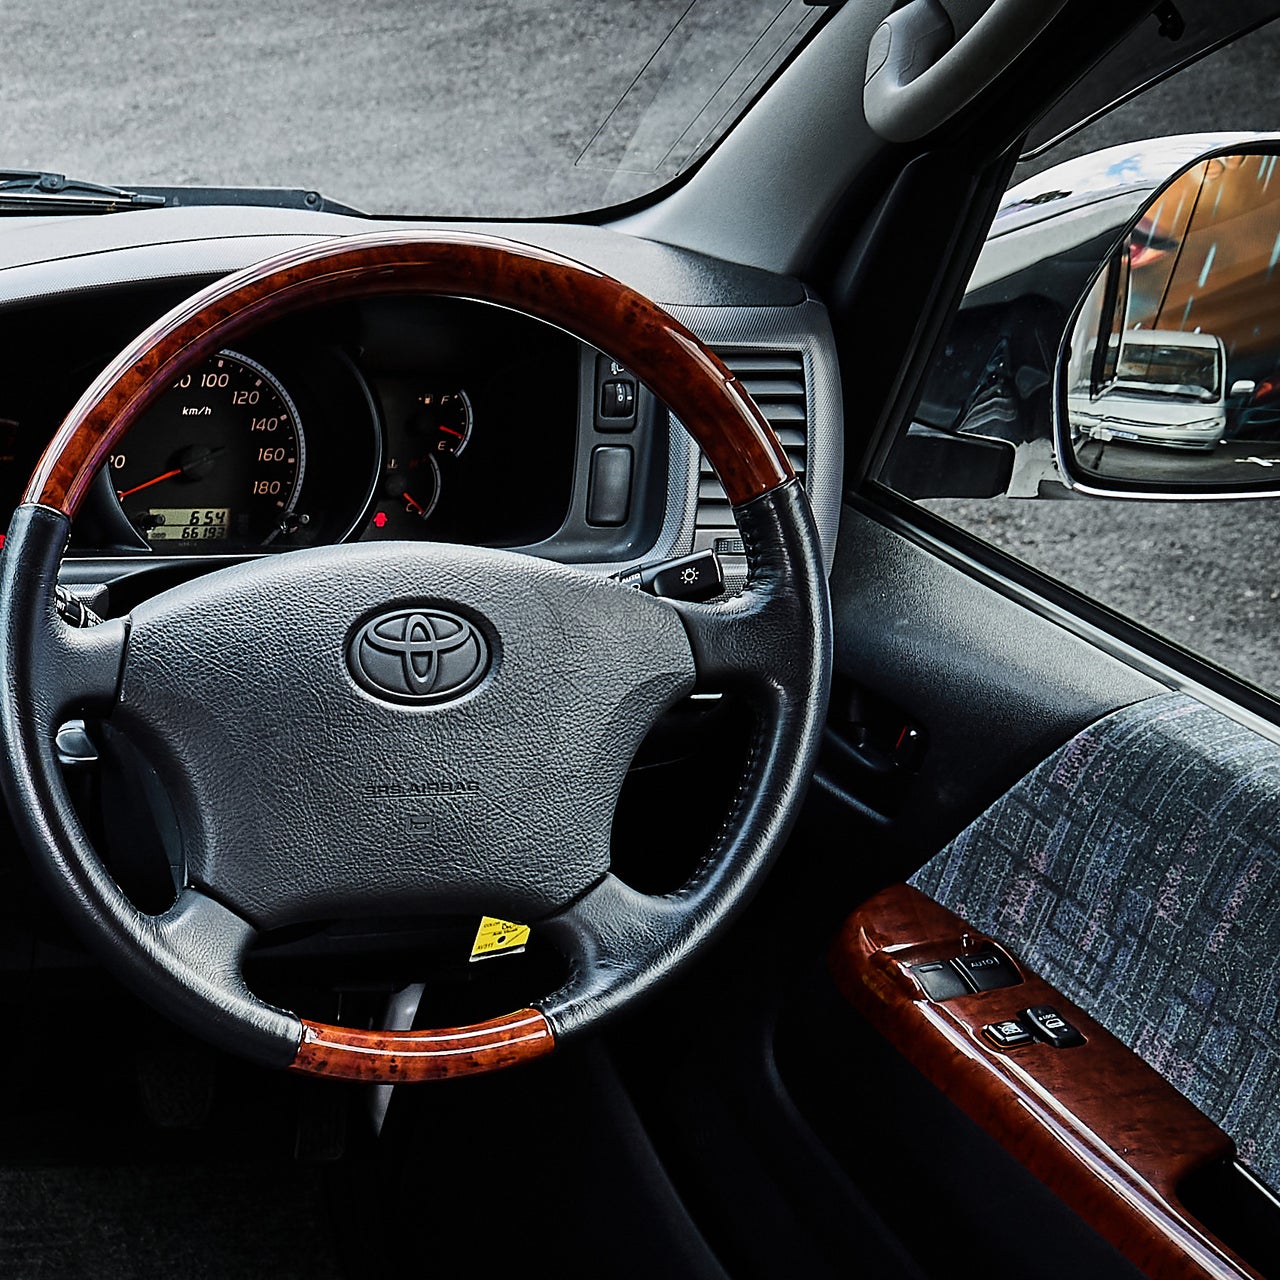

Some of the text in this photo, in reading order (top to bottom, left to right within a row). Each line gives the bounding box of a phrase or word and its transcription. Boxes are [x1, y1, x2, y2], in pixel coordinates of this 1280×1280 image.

[173, 373, 191, 389] 0
[201, 373, 230, 388] 100
[232, 390, 260, 405] 120
[440, 395, 450, 405] F
[182, 406, 212, 416] km/h
[251, 417, 278, 432] 140
[437, 440, 447, 451] E
[258, 447, 285, 461] 160
[253, 481, 281, 495] 180
[622, 572, 640, 583] AUTO
[971, 958, 994, 968] AUTO
